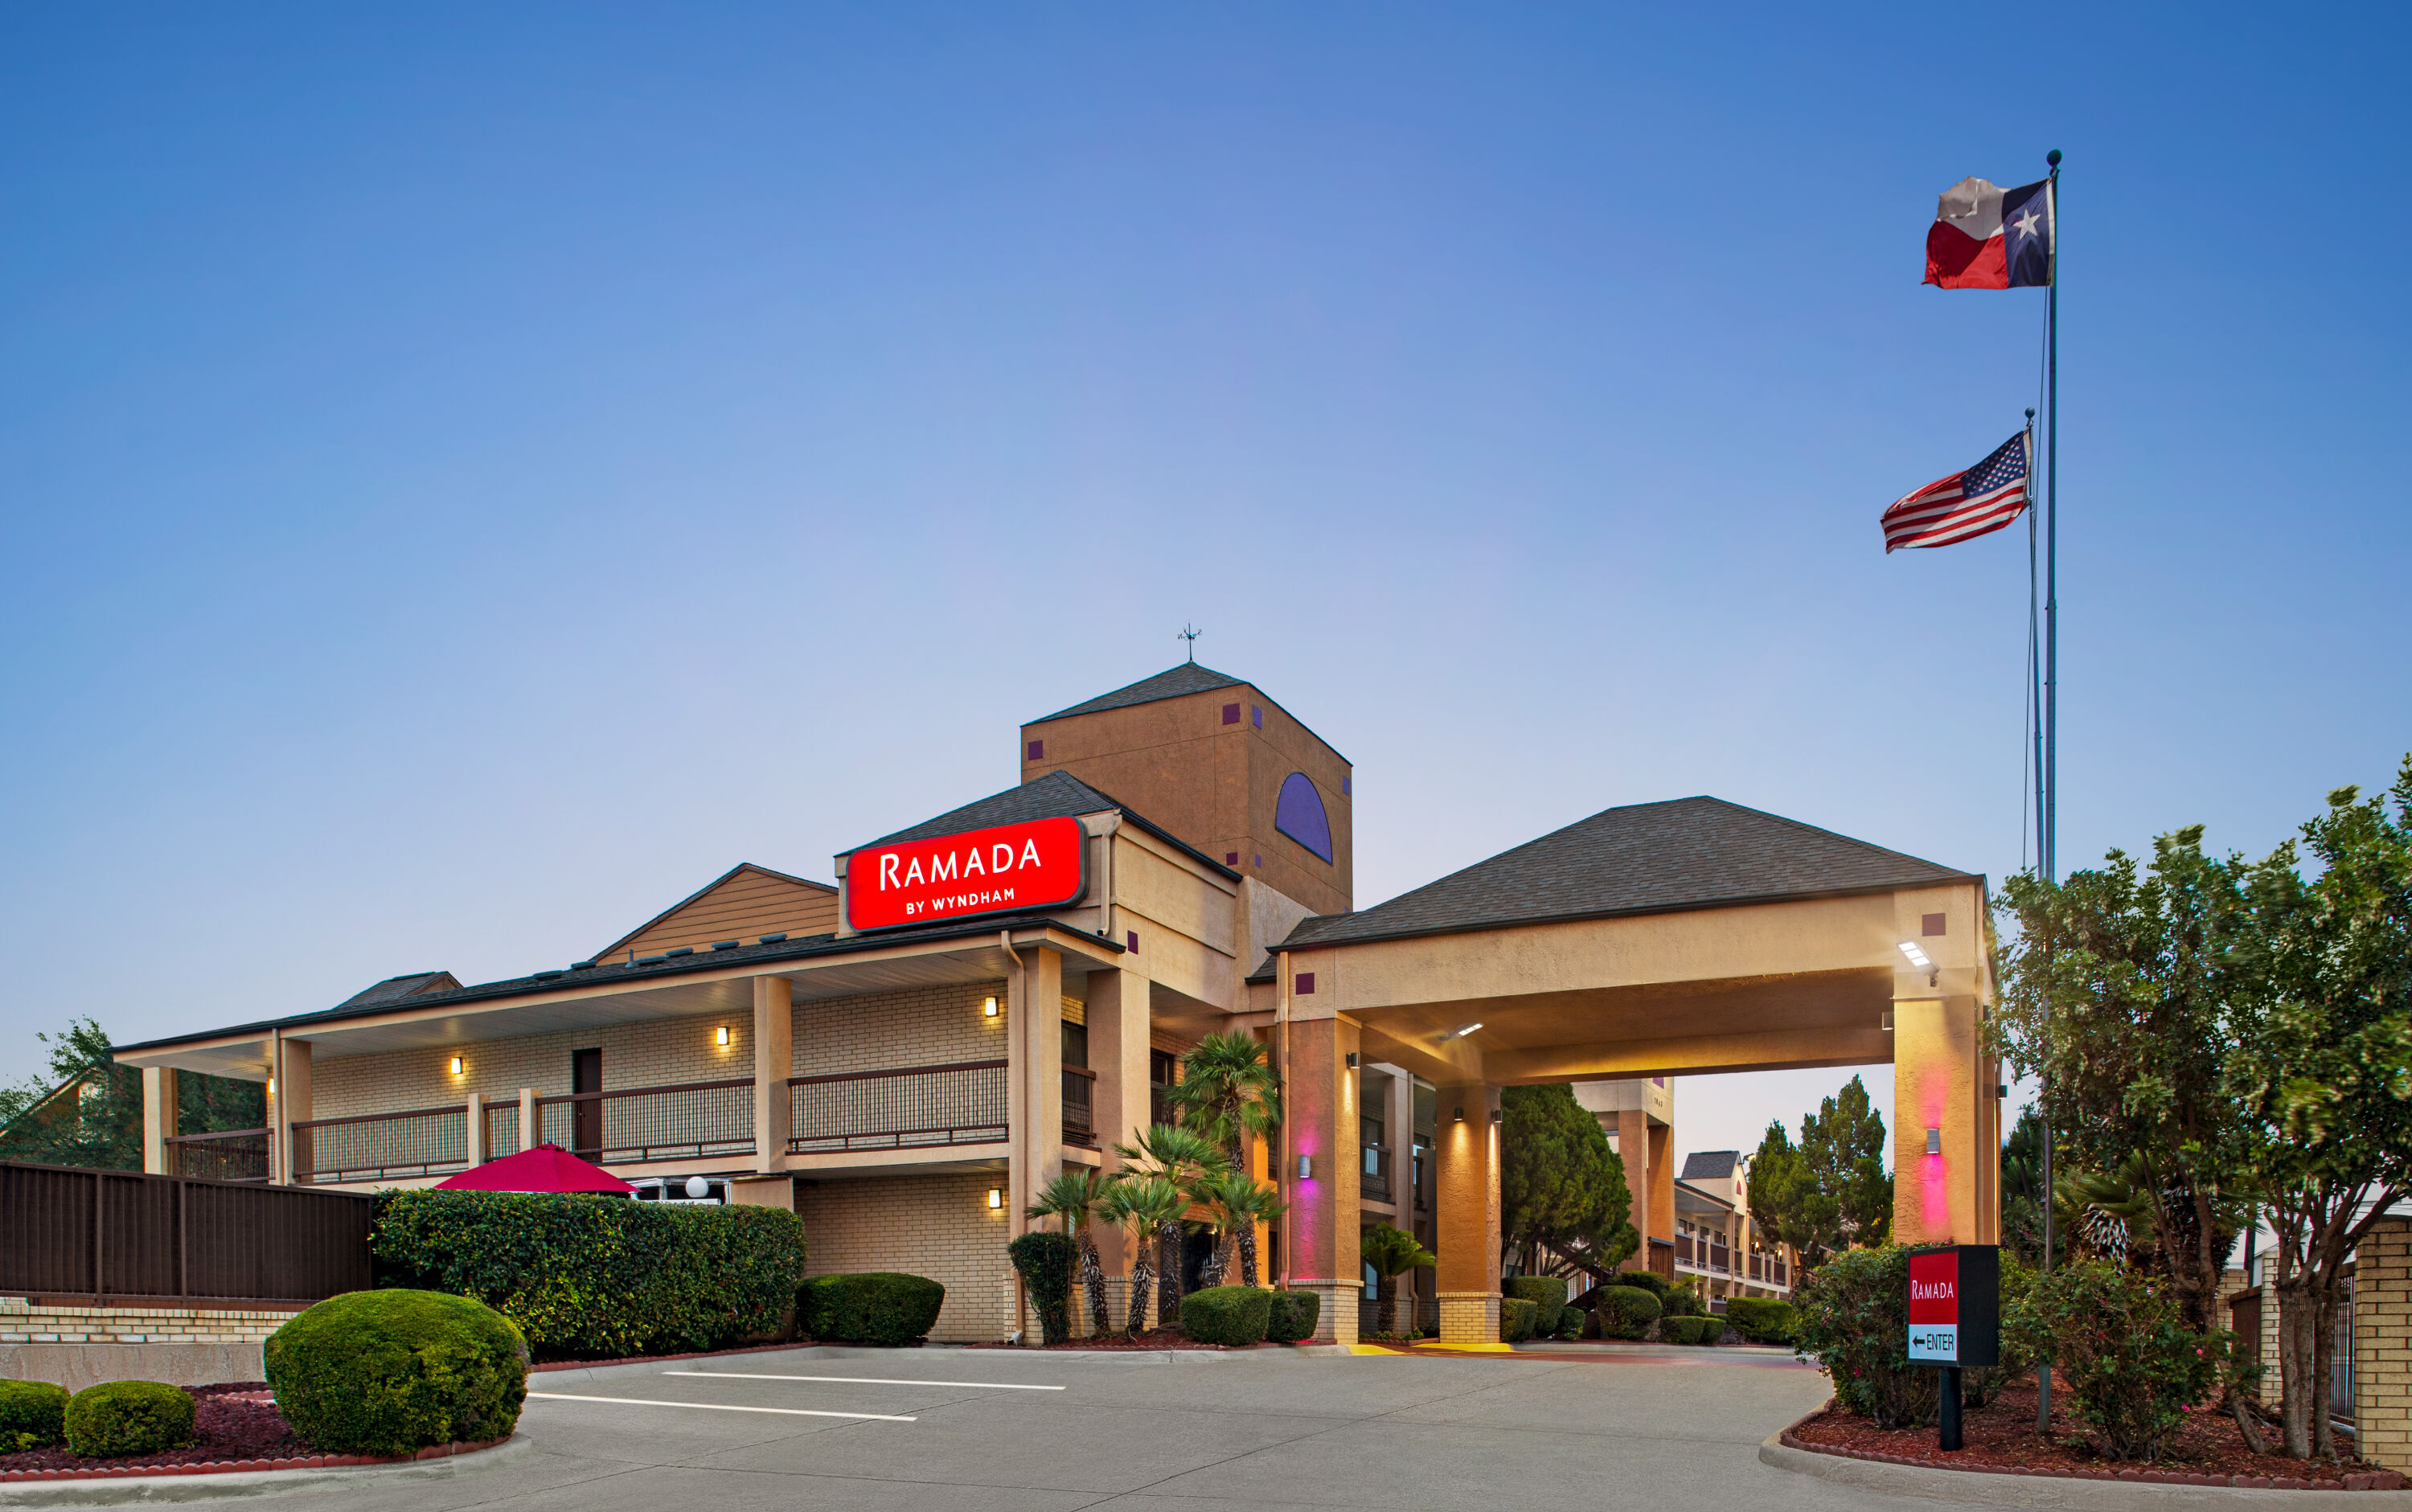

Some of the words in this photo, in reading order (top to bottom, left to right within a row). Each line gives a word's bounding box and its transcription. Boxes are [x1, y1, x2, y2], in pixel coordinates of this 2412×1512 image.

[880, 838, 1041, 891] RAMADA
[906, 901, 925, 915] BY
[932, 888, 1015, 910] WYNDHAM
[1912, 1280, 1954, 1300] RAMADA
[1926, 1334, 1954, 1351] ENTER
